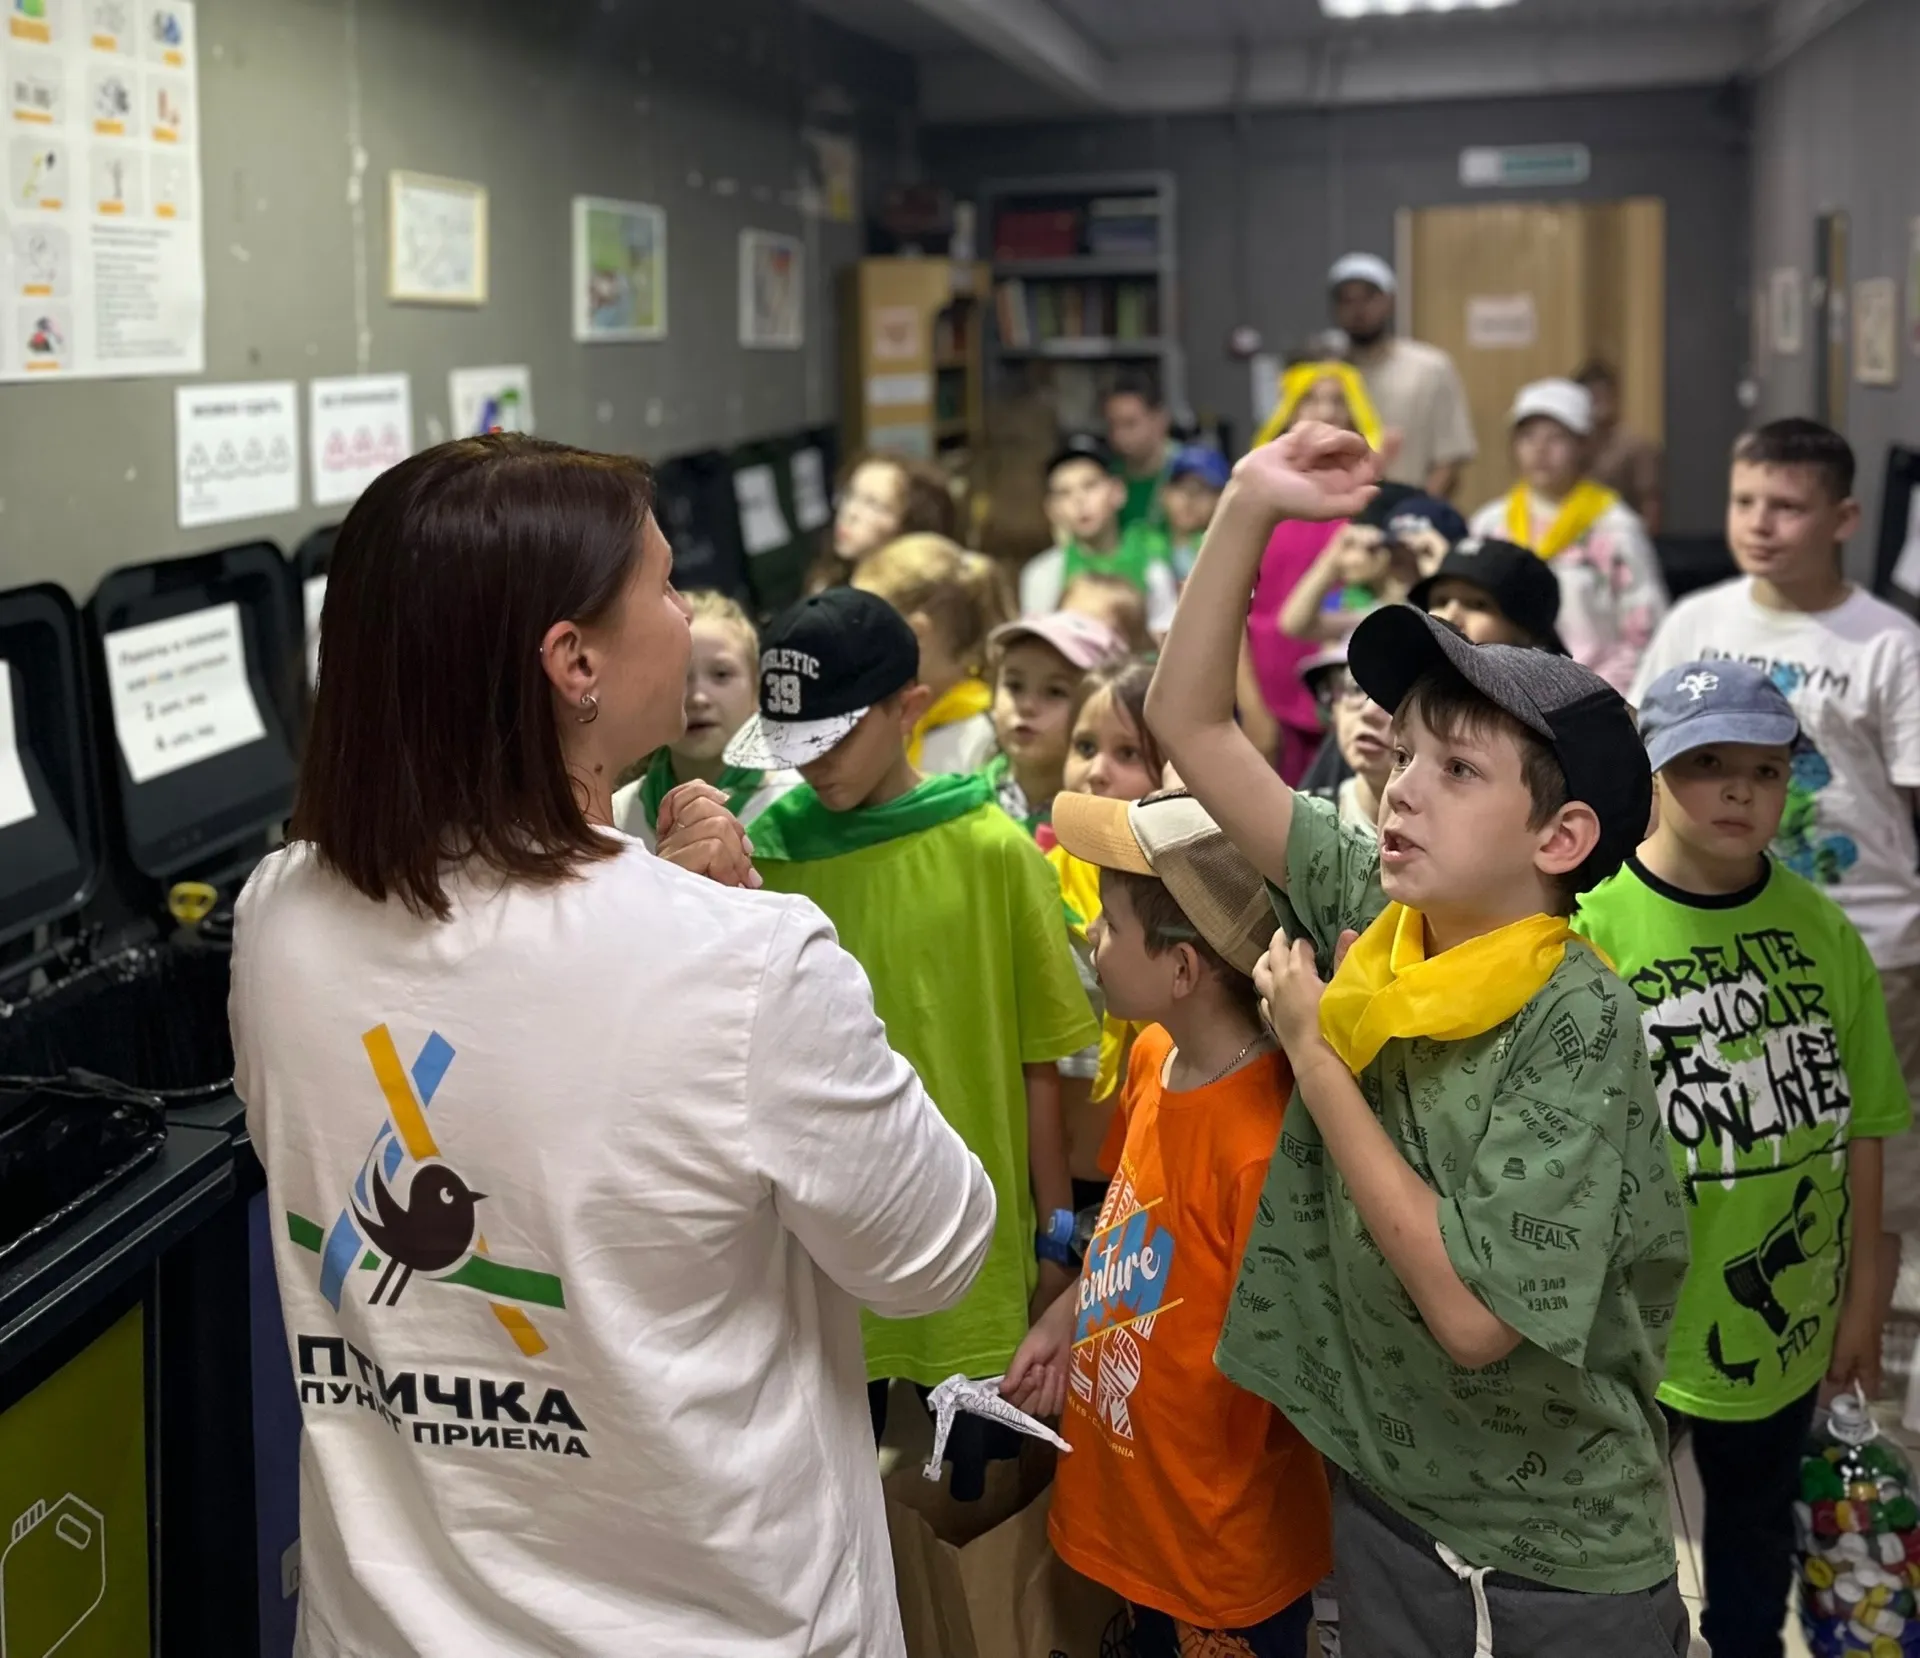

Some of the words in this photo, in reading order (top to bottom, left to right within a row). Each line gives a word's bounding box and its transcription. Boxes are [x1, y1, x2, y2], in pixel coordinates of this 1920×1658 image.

[765, 673, 801, 714] 39
[1628, 928, 1816, 1006] CREATE
[1698, 981, 1830, 1044] YOUR
[1667, 1058, 1851, 1153] ONLINE
[1521, 1220, 1567, 1250] REAL
[1527, 1295, 1568, 1312] NEVER
[1540, 1276, 1566, 1292] GIVE
[297, 1333, 588, 1432] ПТИЧКА
[301, 1380, 402, 1434] ПУНКТ
[413, 1421, 591, 1458] ПРИЕМА
